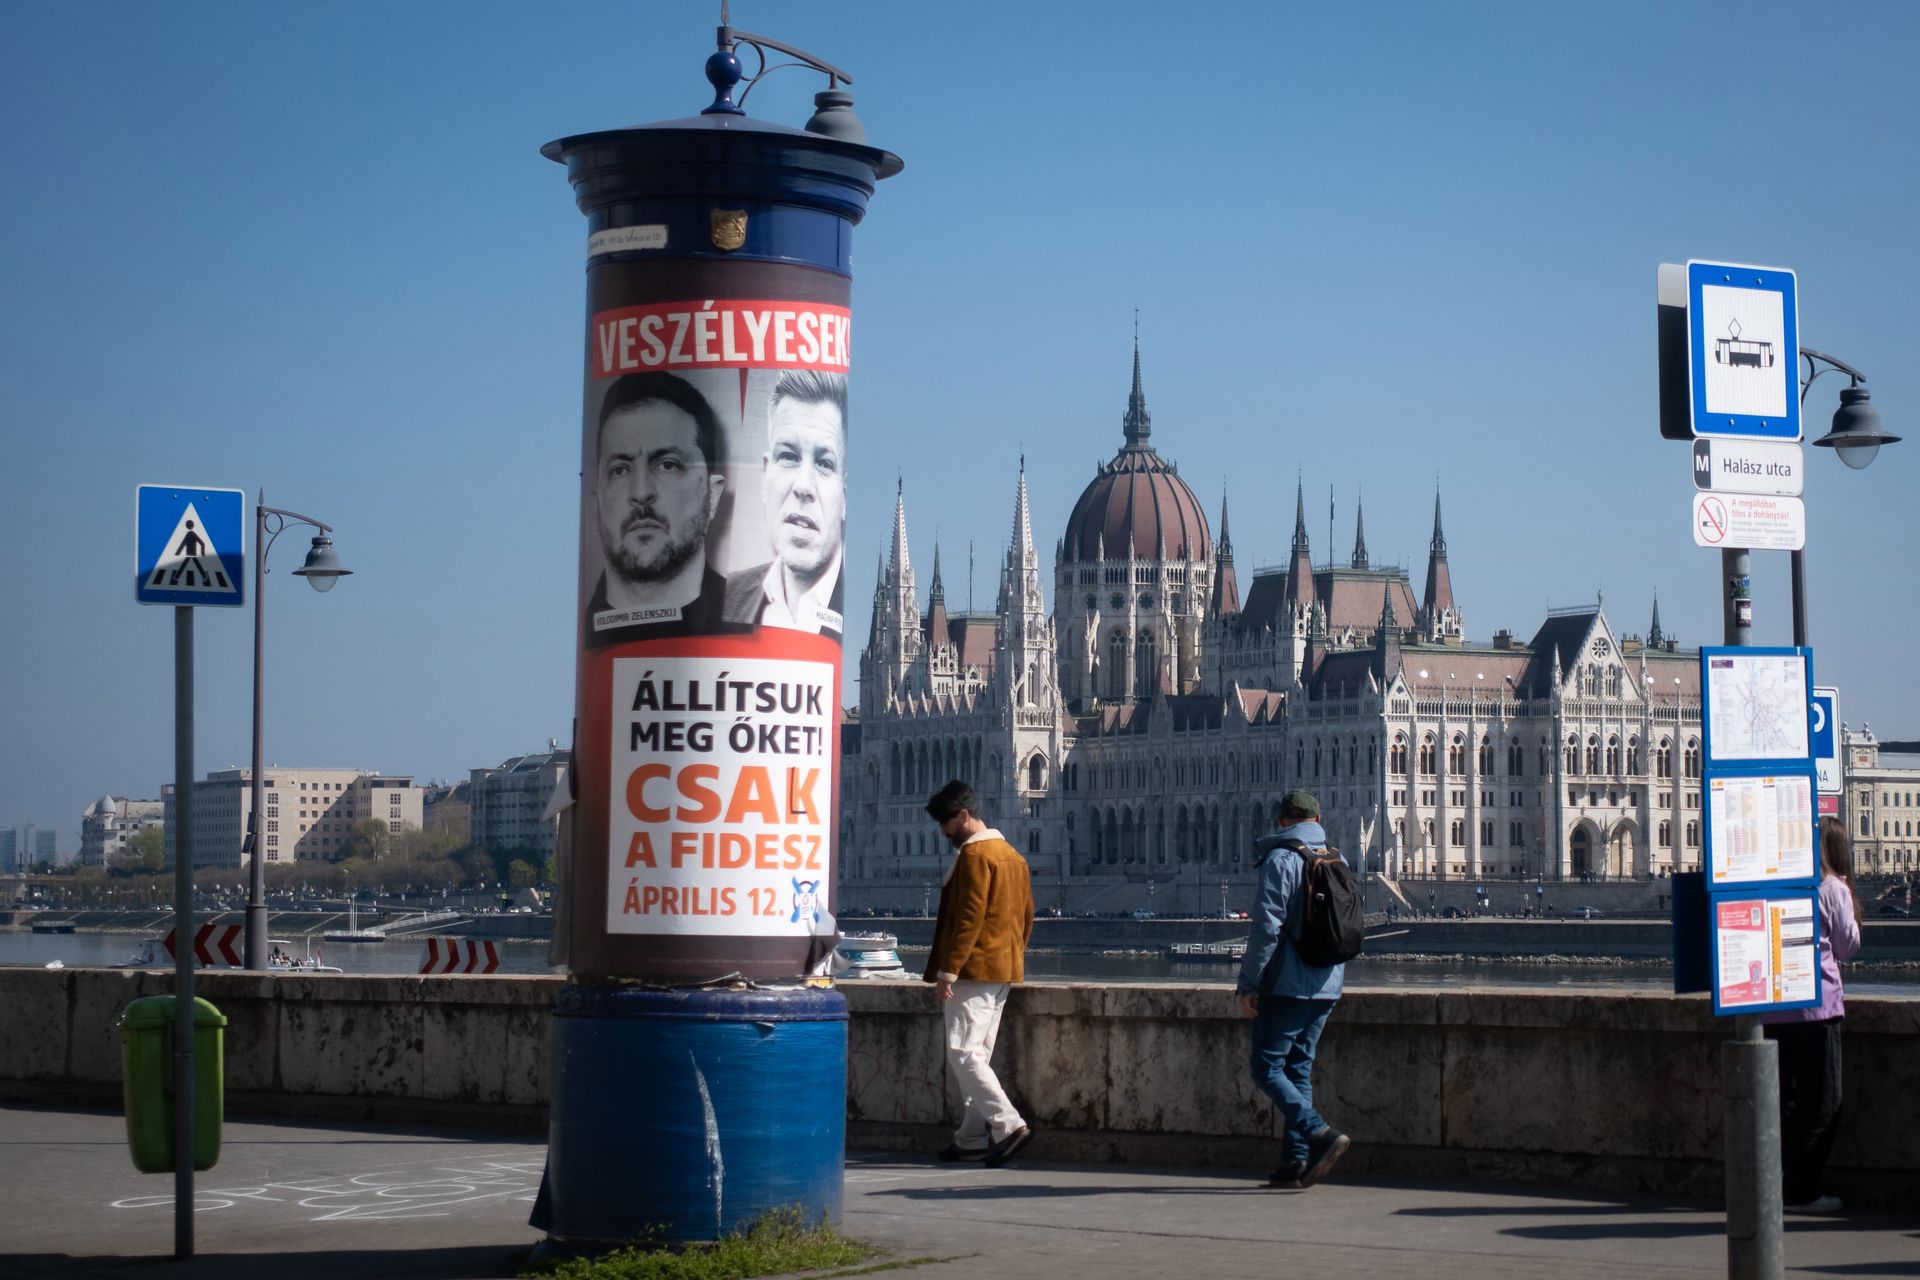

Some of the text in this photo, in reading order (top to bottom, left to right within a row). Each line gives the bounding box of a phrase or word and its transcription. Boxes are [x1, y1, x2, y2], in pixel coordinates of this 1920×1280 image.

[1695, 455, 1791, 477] M Halász utca
[1732, 510, 1746, 518] tilos
[1753, 510, 1790, 521] dohányzás!
[631, 607, 677, 621] ZELENSZKIJ
[632, 670, 823, 716] ÁLLÍTSUK
[630, 716, 823, 756] MEG ŐKET!
[625, 763, 821, 825] CSAK
[624, 832, 821, 870] A FIDESZ
[623, 877, 784, 917] ÁPRILIS 12.
